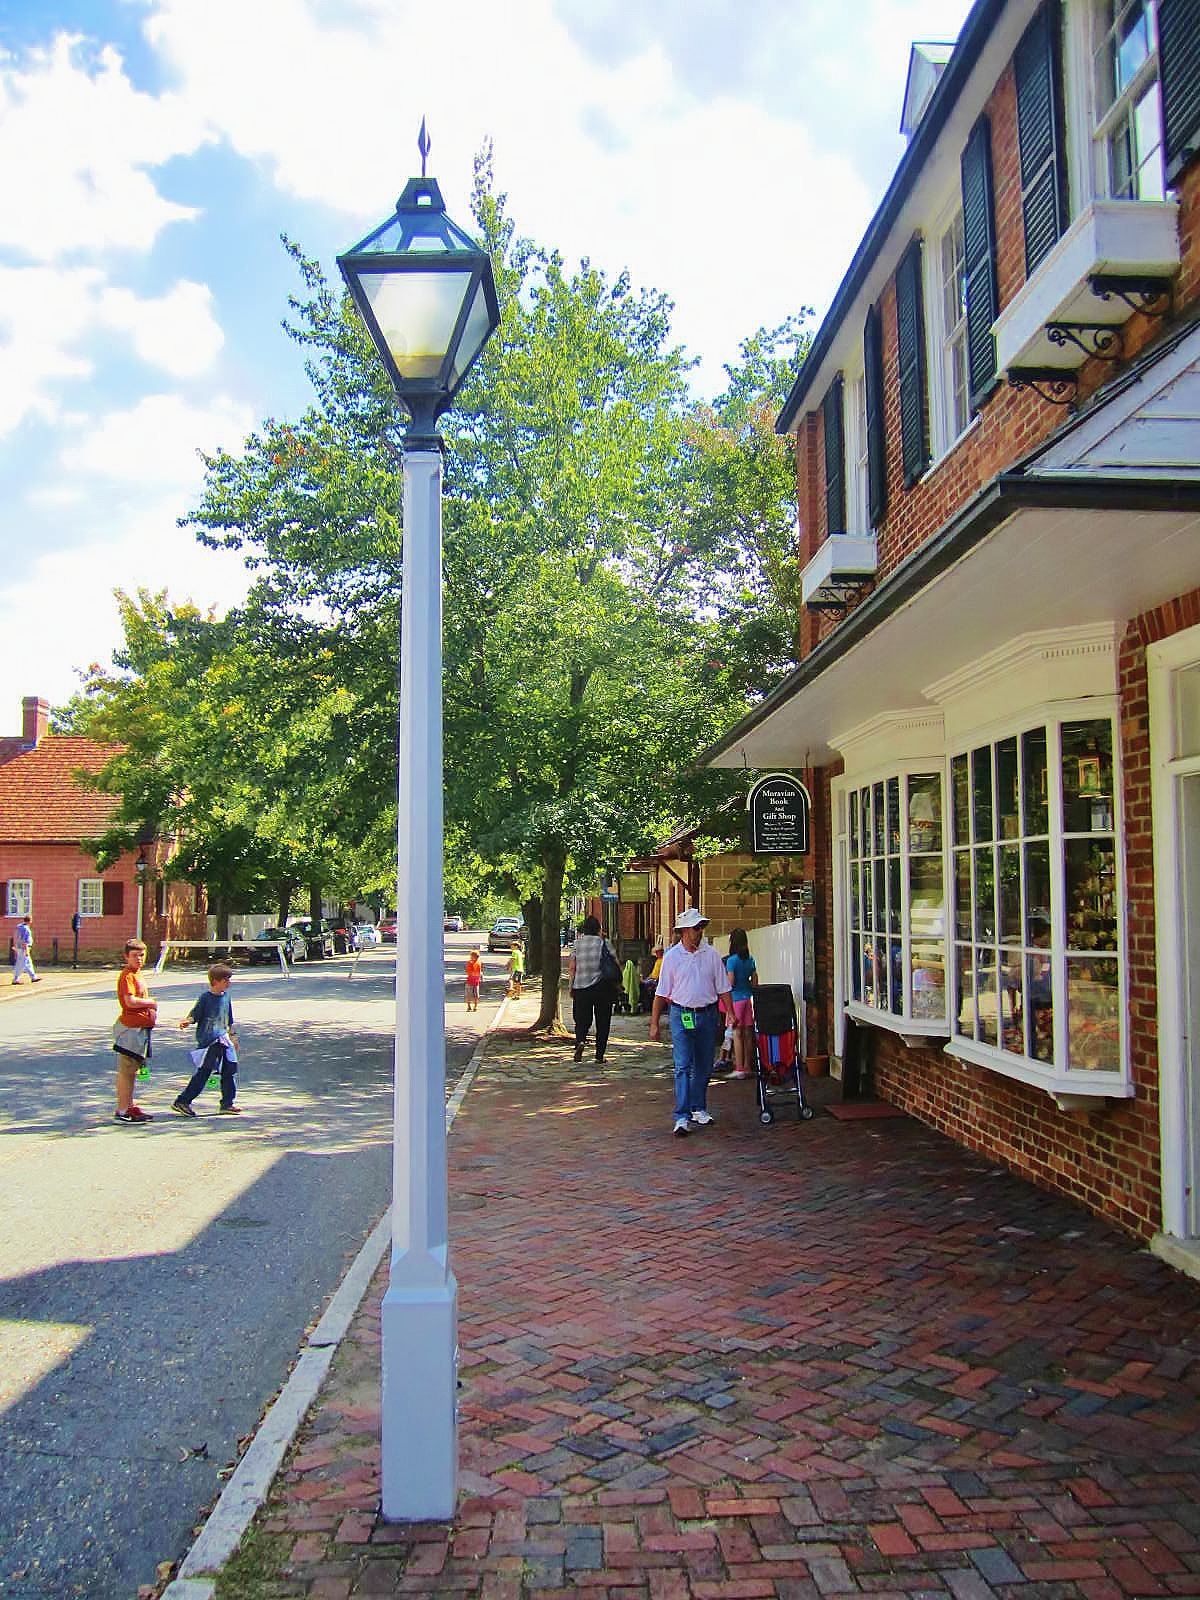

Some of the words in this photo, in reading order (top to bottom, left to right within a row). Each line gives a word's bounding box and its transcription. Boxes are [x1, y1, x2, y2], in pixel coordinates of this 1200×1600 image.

[762, 789, 795, 797] Moravian
[762, 812, 777, 820] Gift
[778, 812, 797, 822] Shop
